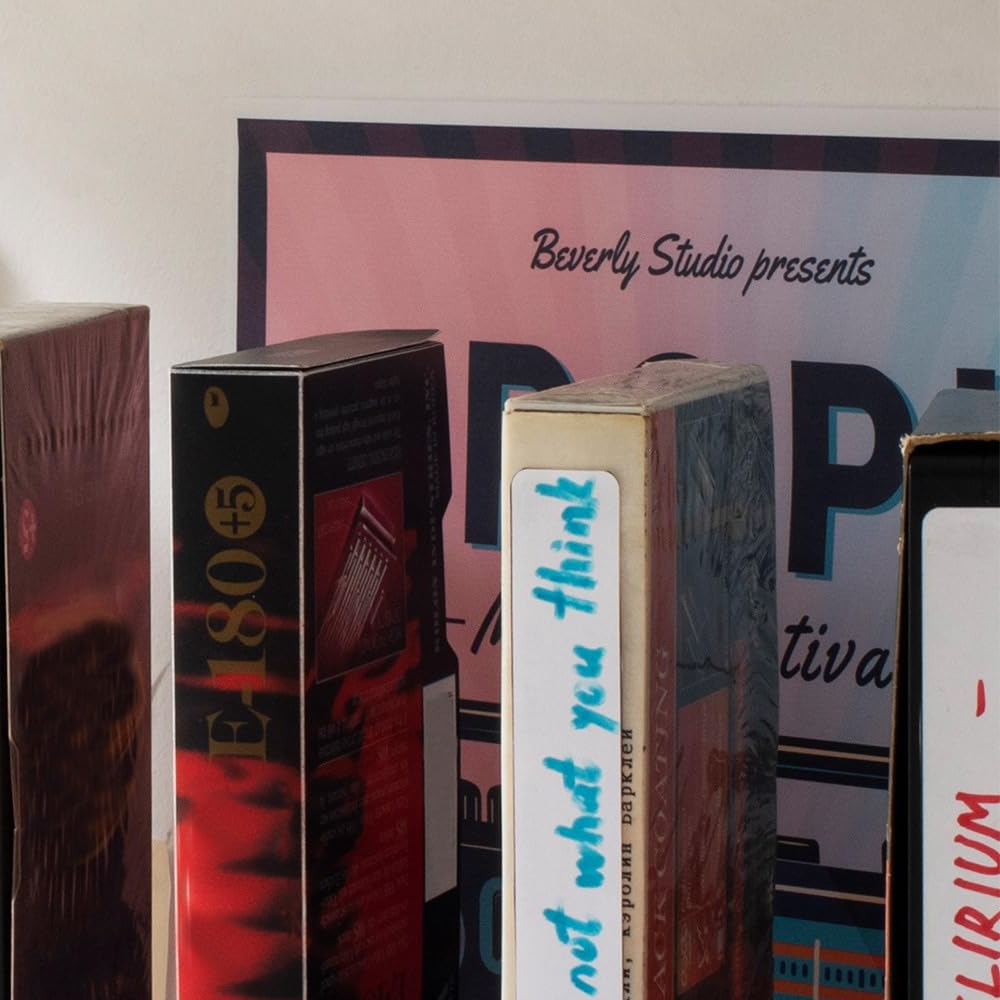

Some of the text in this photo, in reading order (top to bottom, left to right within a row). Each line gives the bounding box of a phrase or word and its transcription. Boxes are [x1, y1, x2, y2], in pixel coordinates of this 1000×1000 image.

[530, 227, 876, 297] Beverly Studio presents
[531, 476, 600, 621] think
[570, 644, 620, 733] you
[651, 644, 671, 881] COATING
[541, 756, 606, 889] what
[542, 898, 603, 997] not
